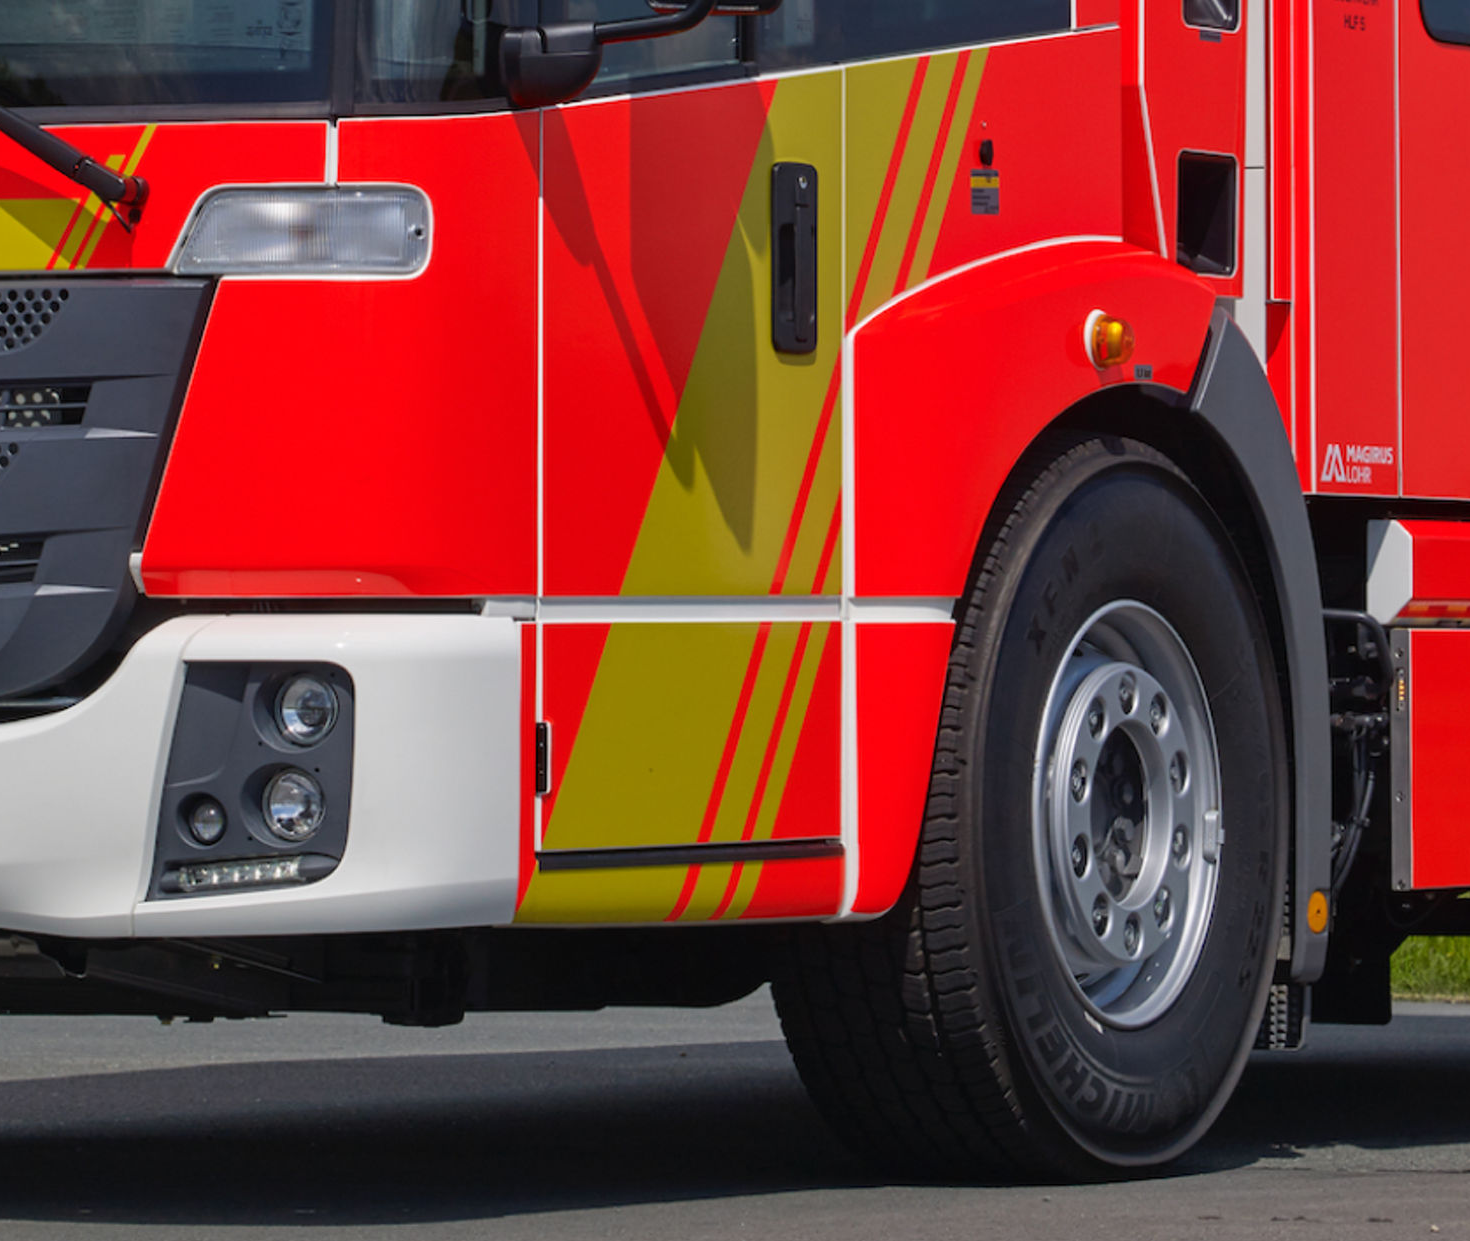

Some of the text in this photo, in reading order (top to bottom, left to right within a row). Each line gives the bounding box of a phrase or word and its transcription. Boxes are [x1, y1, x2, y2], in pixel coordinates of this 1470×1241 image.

[1344, 13, 1359, 30] HLF
[1346, 445, 1394, 464] MAGIRUS
[1346, 465, 1372, 484] LOHR
[998, 918, 1156, 1132] MICHELIN
